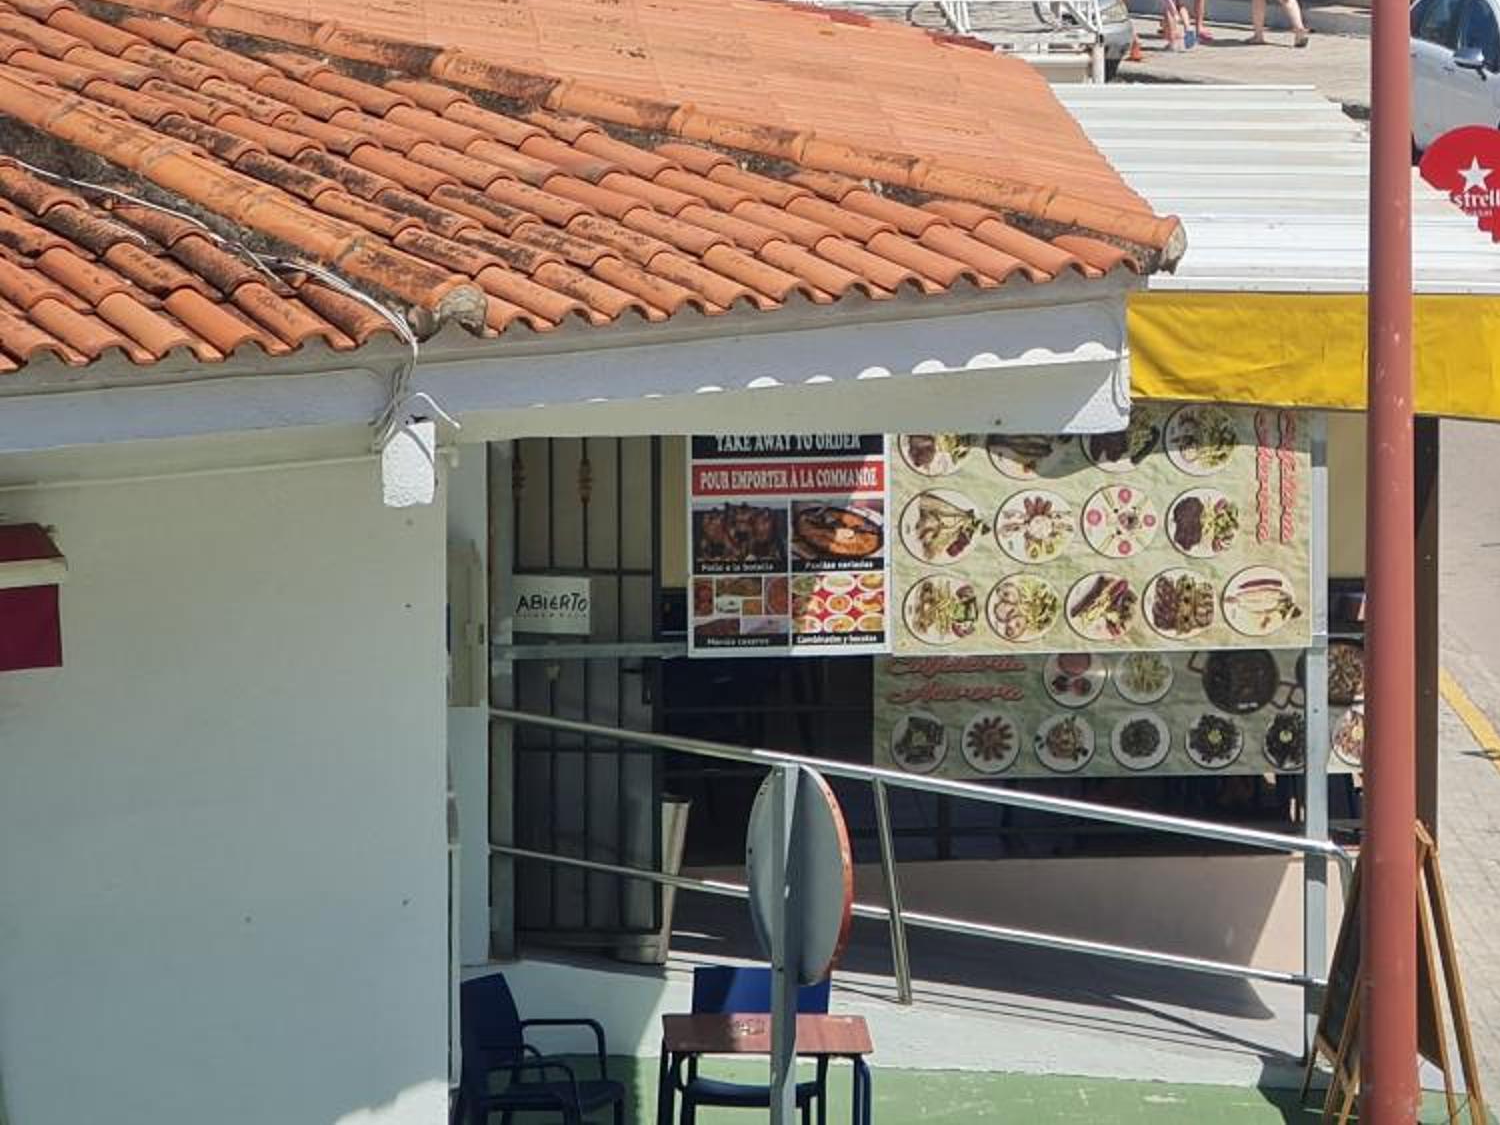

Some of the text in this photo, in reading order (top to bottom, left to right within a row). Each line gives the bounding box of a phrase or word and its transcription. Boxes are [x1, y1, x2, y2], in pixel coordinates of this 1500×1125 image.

[754, 434, 791, 451] AWAY
[701, 470, 730, 490] POUR
[731, 468, 789, 489] EMPORTER
[800, 467, 815, 488] LA
[816, 465, 878, 487] COMMANDE
[515, 592, 587, 613] ABIERTO
